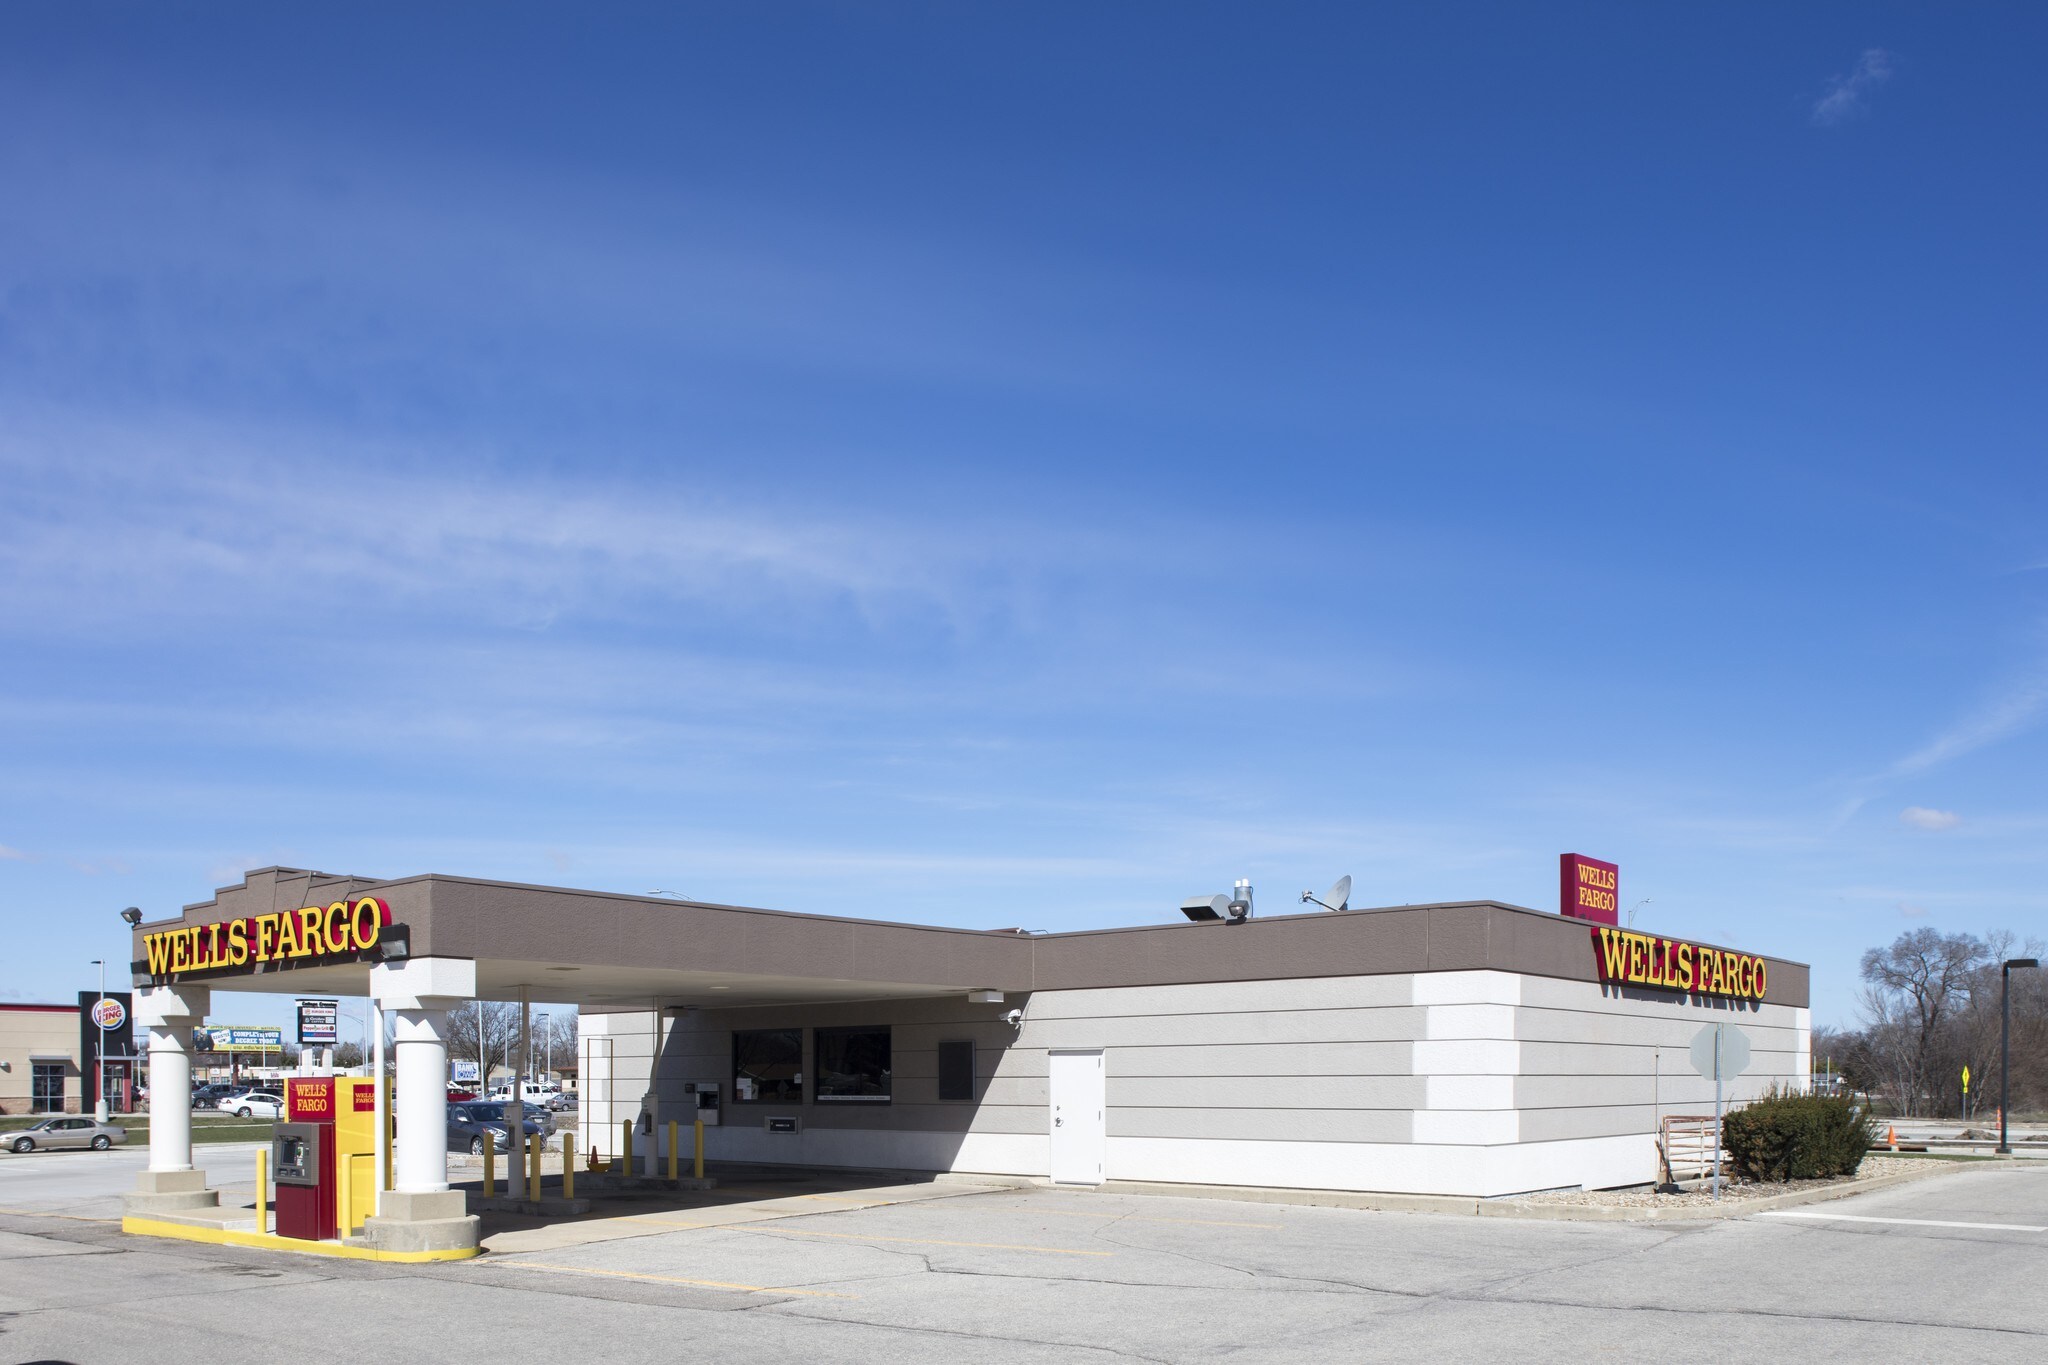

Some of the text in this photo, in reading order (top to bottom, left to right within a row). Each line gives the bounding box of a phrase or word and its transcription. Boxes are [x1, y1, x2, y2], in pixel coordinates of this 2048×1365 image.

[1577, 864, 1616, 890] WELLS
[1578, 886, 1616, 912] FARGO
[143, 896, 384, 976] WELLS FARGO
[1598, 927, 1768, 1000] WELLS FARGO
[98, 1009, 123, 1023] KING
[457, 1063, 474, 1072] BANK
[296, 1084, 327, 1097] WELLS
[296, 1098, 327, 1112] FARGO
